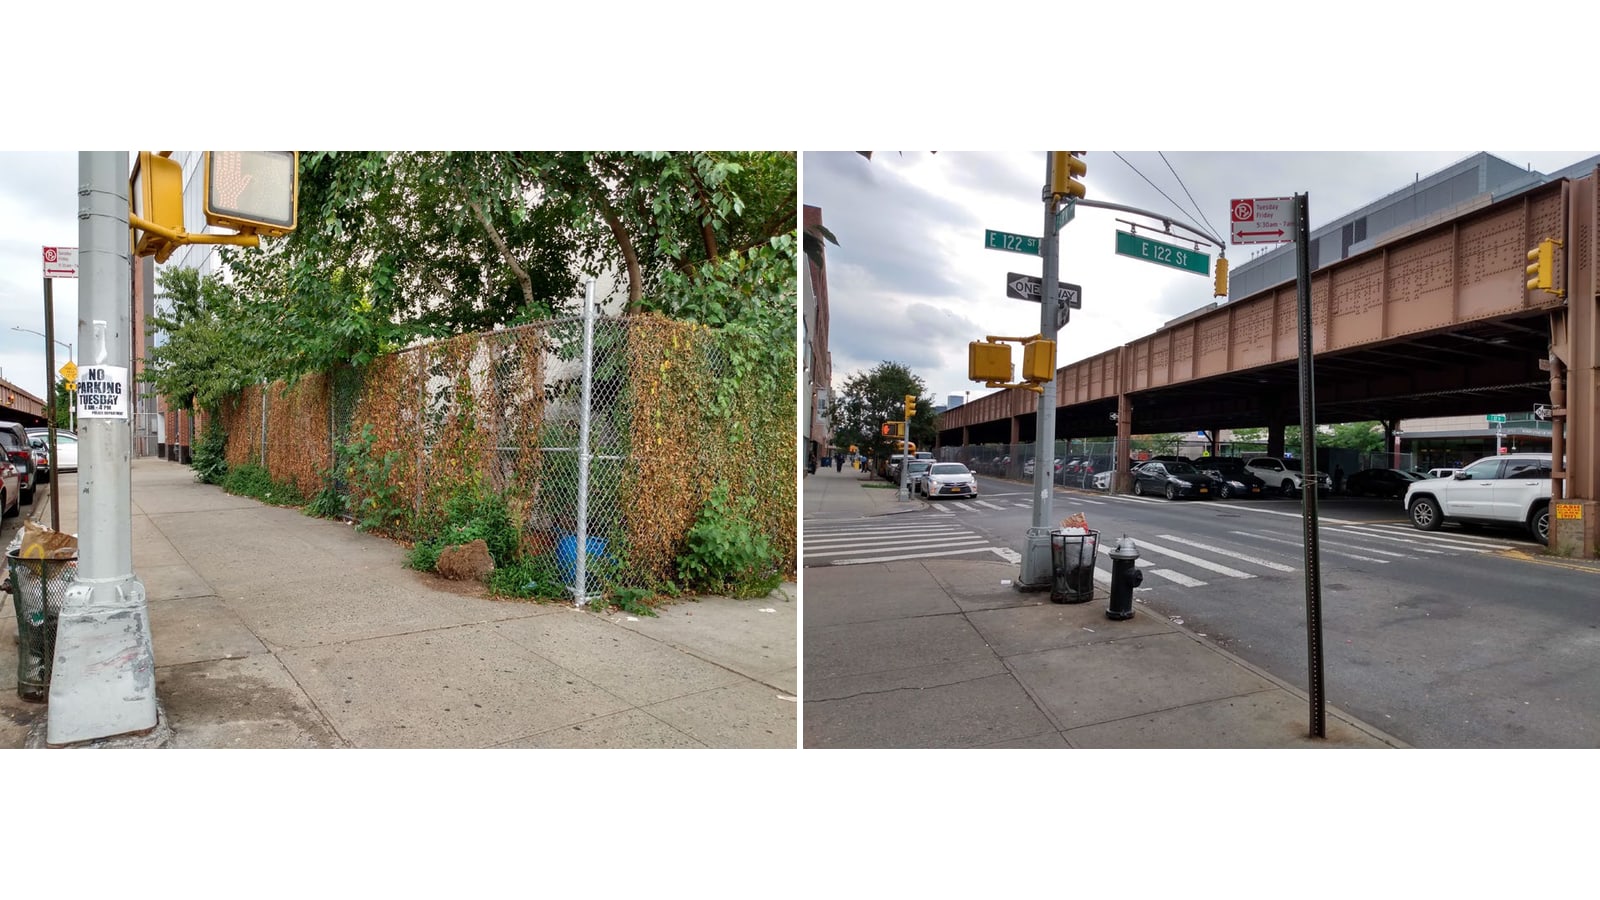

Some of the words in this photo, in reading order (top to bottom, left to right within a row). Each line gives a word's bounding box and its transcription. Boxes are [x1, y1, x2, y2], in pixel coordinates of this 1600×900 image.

[990, 231, 997, 247] E
[1003, 234, 1023, 251] 122
[1027, 238, 1037, 247] ST
[1142, 242, 1149, 257] E
[1153, 245, 1172, 262] 122
[1176, 251, 1188, 266] St
[1015, 281, 1041, 295] ONE
[88, 368, 105, 381] NO
[77, 381, 122, 394] PARKING
[79, 394, 119, 405] TUESDAY
